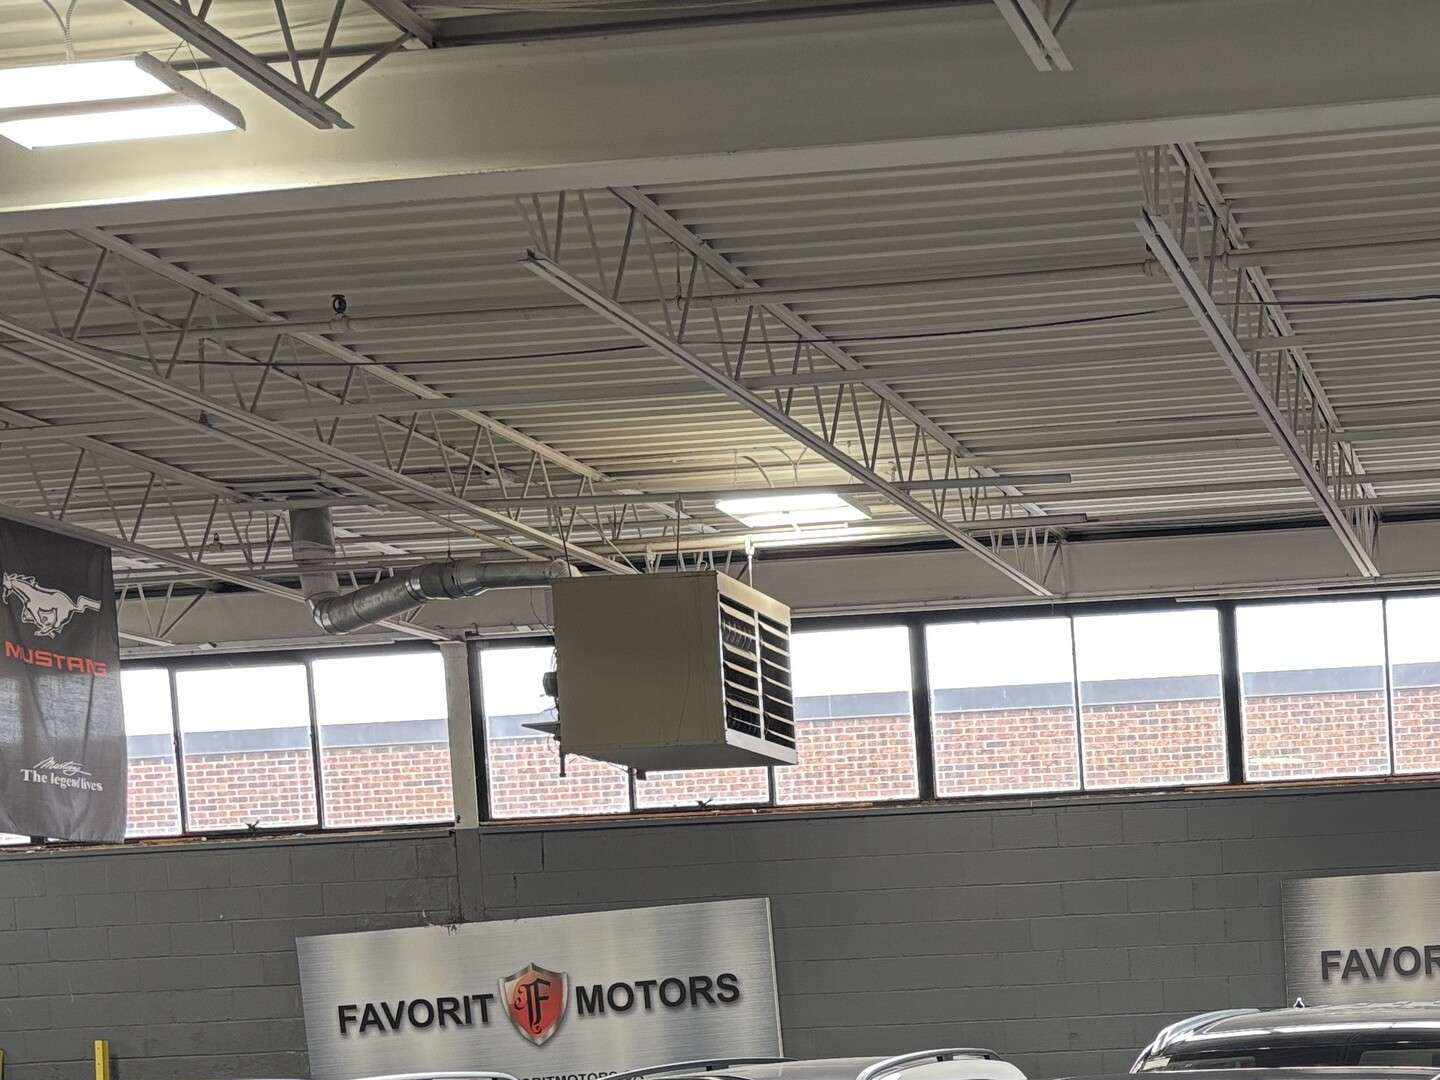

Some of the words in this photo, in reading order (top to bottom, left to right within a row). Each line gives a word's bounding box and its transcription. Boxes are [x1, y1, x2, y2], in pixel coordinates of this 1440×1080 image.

[4, 640, 107, 678] MUSTANG
[20, 768, 48, 784] The
[80, 777, 104, 792] lives
[337, 993, 494, 1034] FAVORIT
[575, 972, 740, 1016] MOTORS
